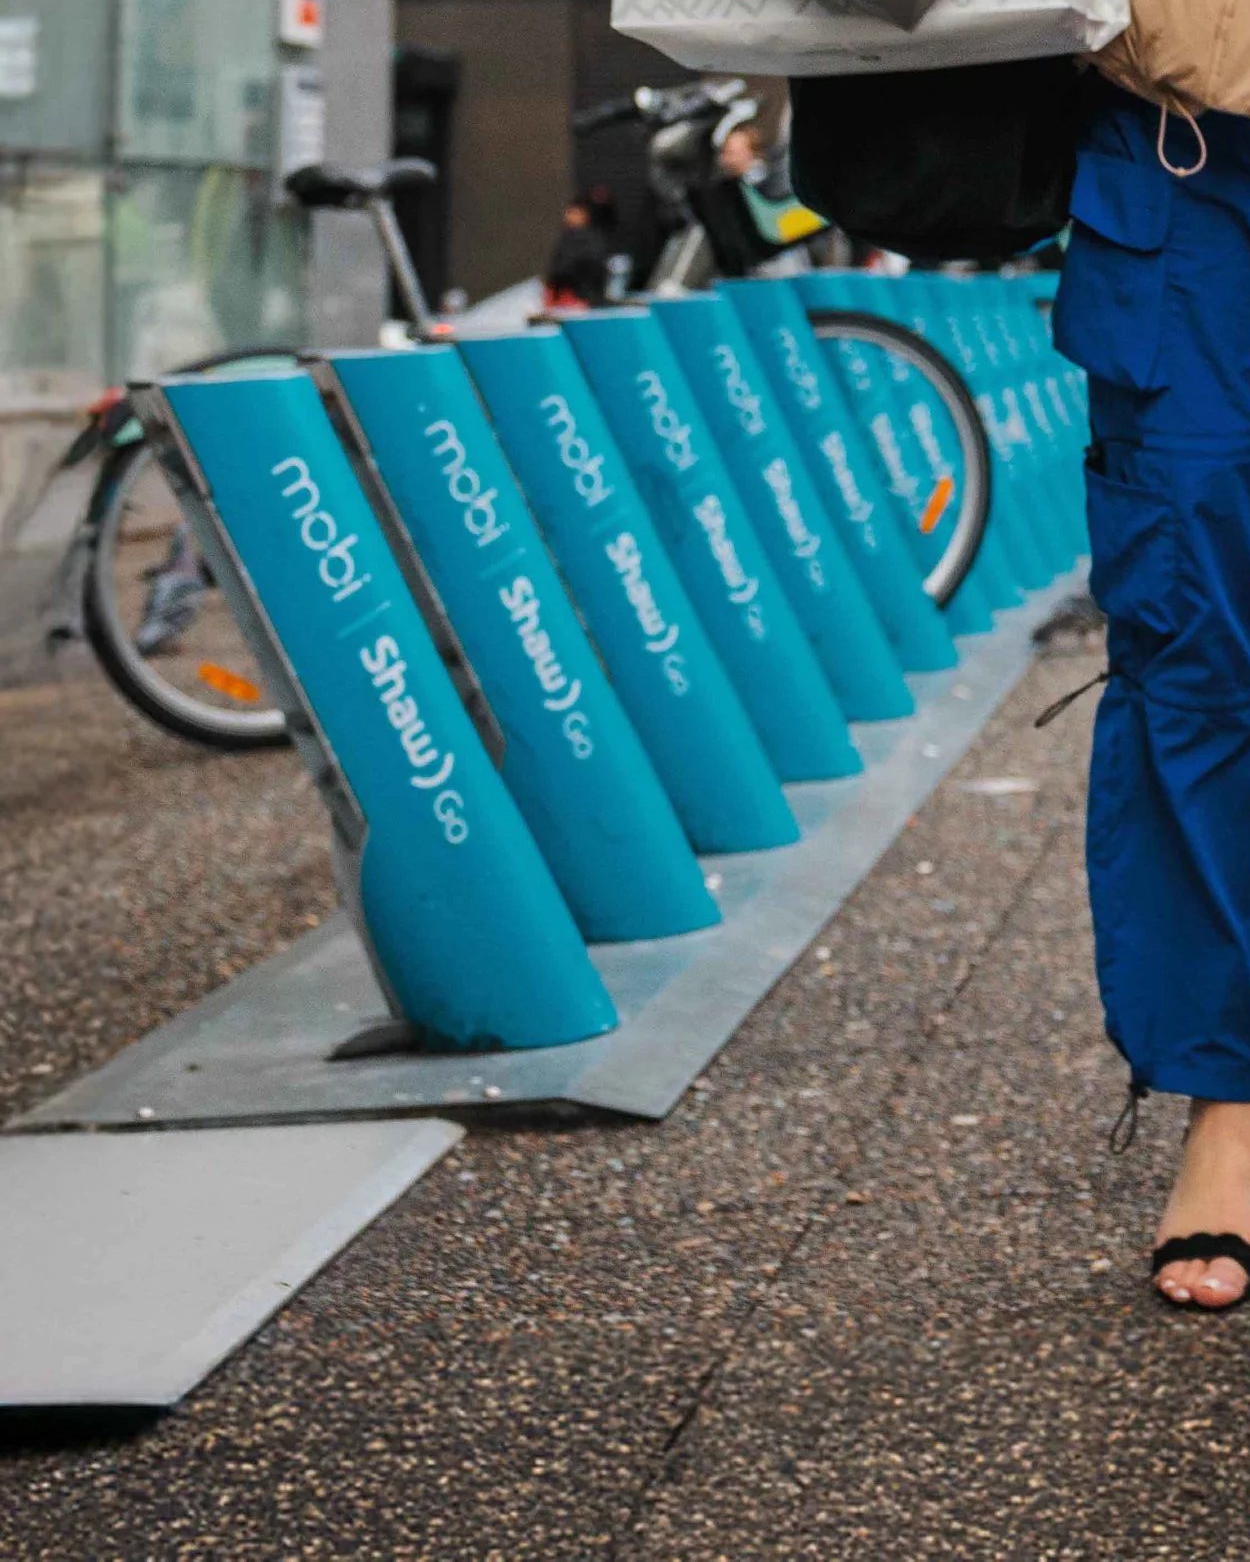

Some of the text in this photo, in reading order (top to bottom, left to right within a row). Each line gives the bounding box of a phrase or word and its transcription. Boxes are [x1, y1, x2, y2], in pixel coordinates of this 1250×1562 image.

[424, 418, 511, 549] mobi
[271, 455, 372, 603] mobi
[432, 788, 469, 845] Go
